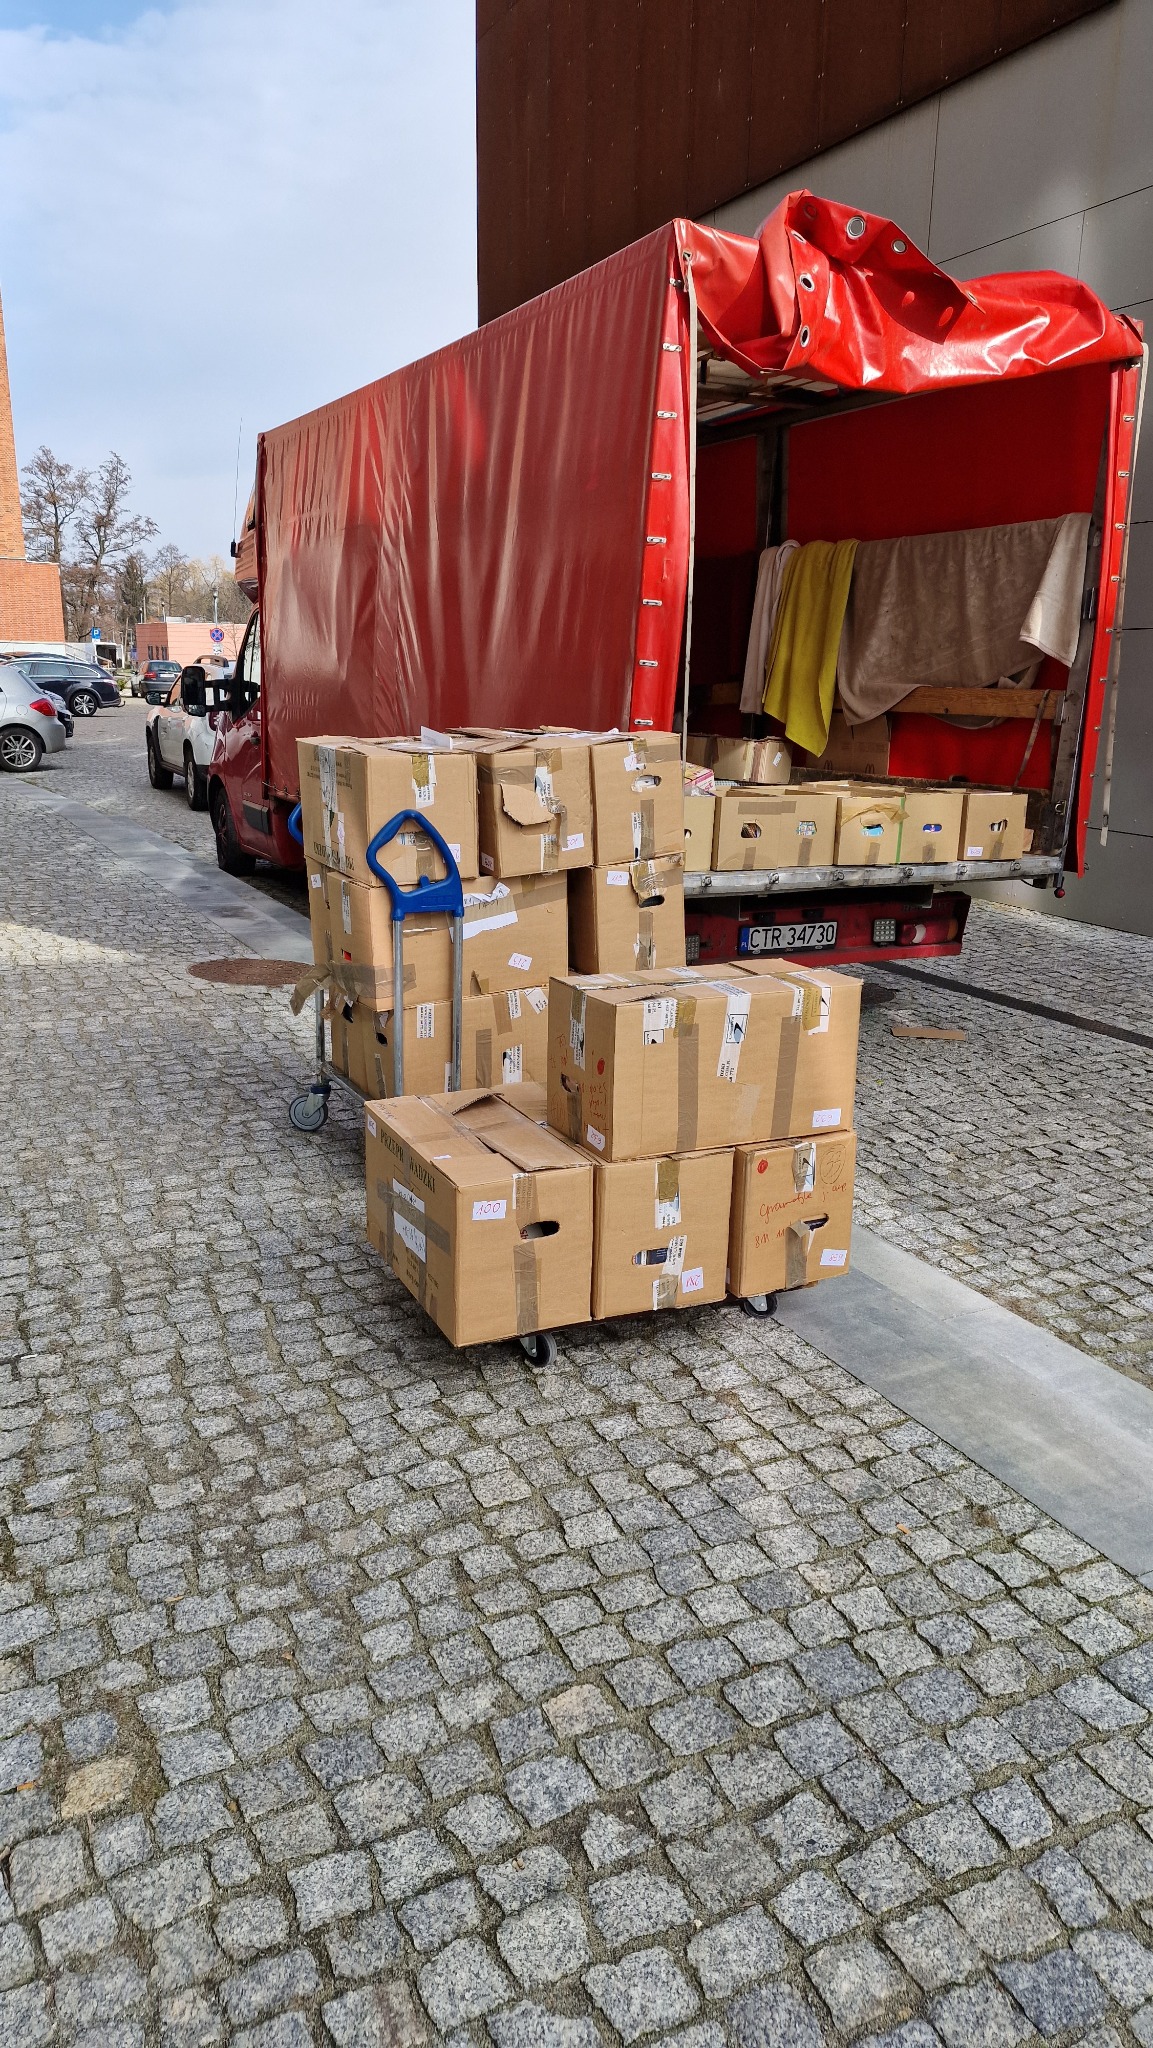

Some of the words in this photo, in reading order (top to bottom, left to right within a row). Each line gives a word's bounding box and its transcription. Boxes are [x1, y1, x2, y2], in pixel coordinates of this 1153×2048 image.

[750, 927, 781, 949] CTR
[787, 924, 835, 947] 34730
[380, 1128, 436, 1193] PRZEPRWADZKI
[475, 1202, 501, 1216] 100
